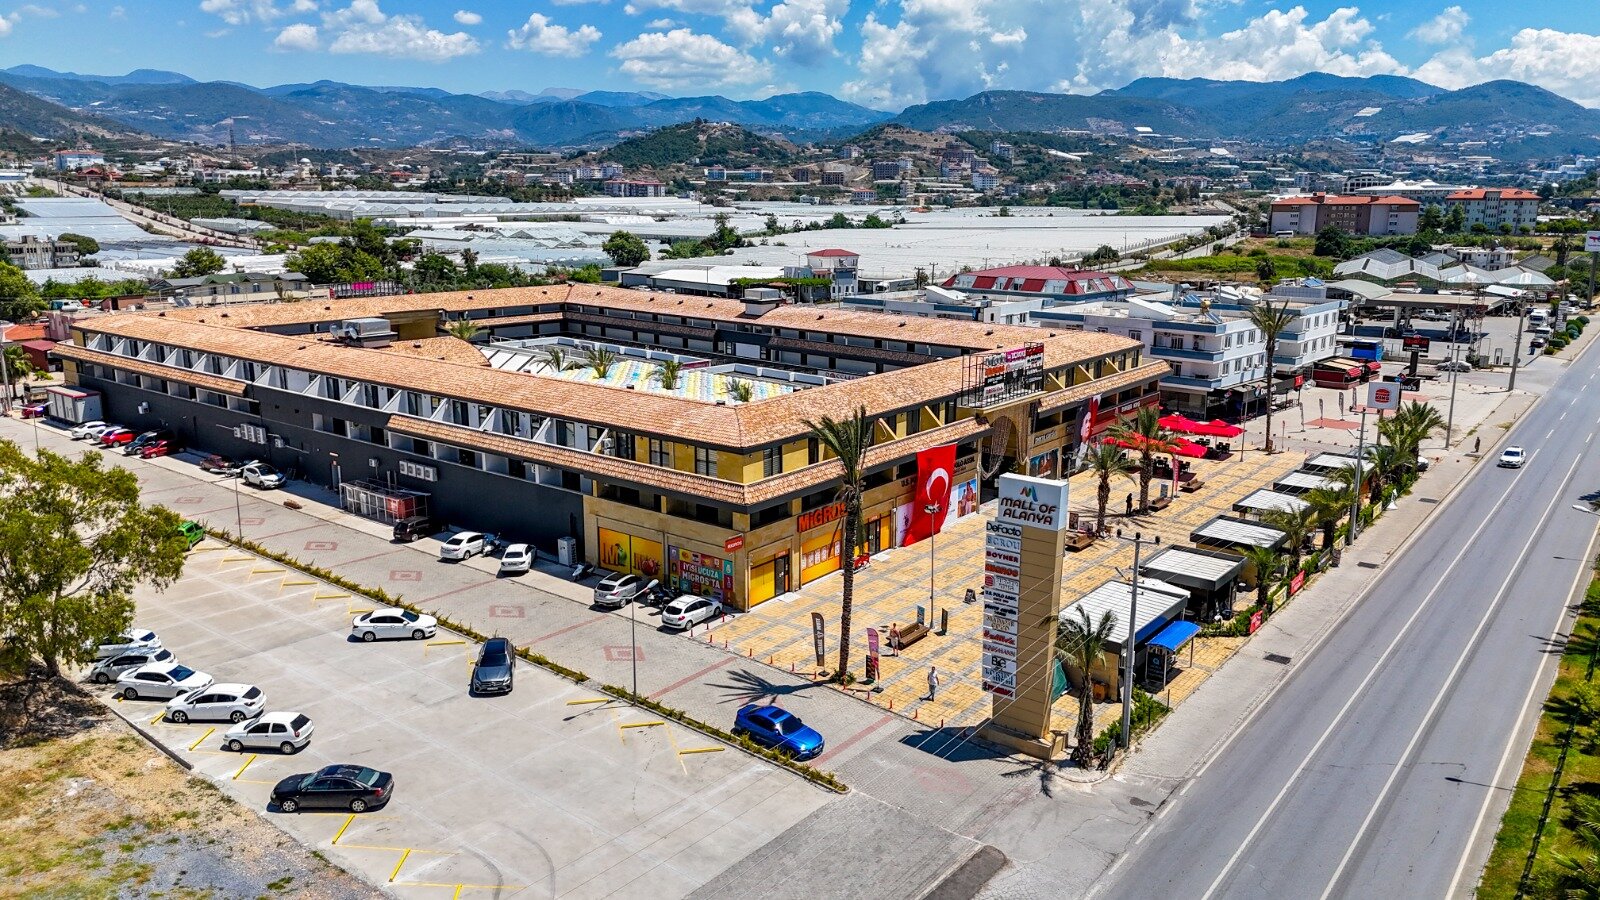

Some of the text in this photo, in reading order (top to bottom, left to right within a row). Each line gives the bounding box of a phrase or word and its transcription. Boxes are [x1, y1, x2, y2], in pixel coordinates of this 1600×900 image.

[1000, 497, 1057, 515] MALL OF
[1003, 508, 1053, 526] ALANYA
[986, 522, 1022, 537] DeFacto
[986, 551, 1019, 563] BOYNER
